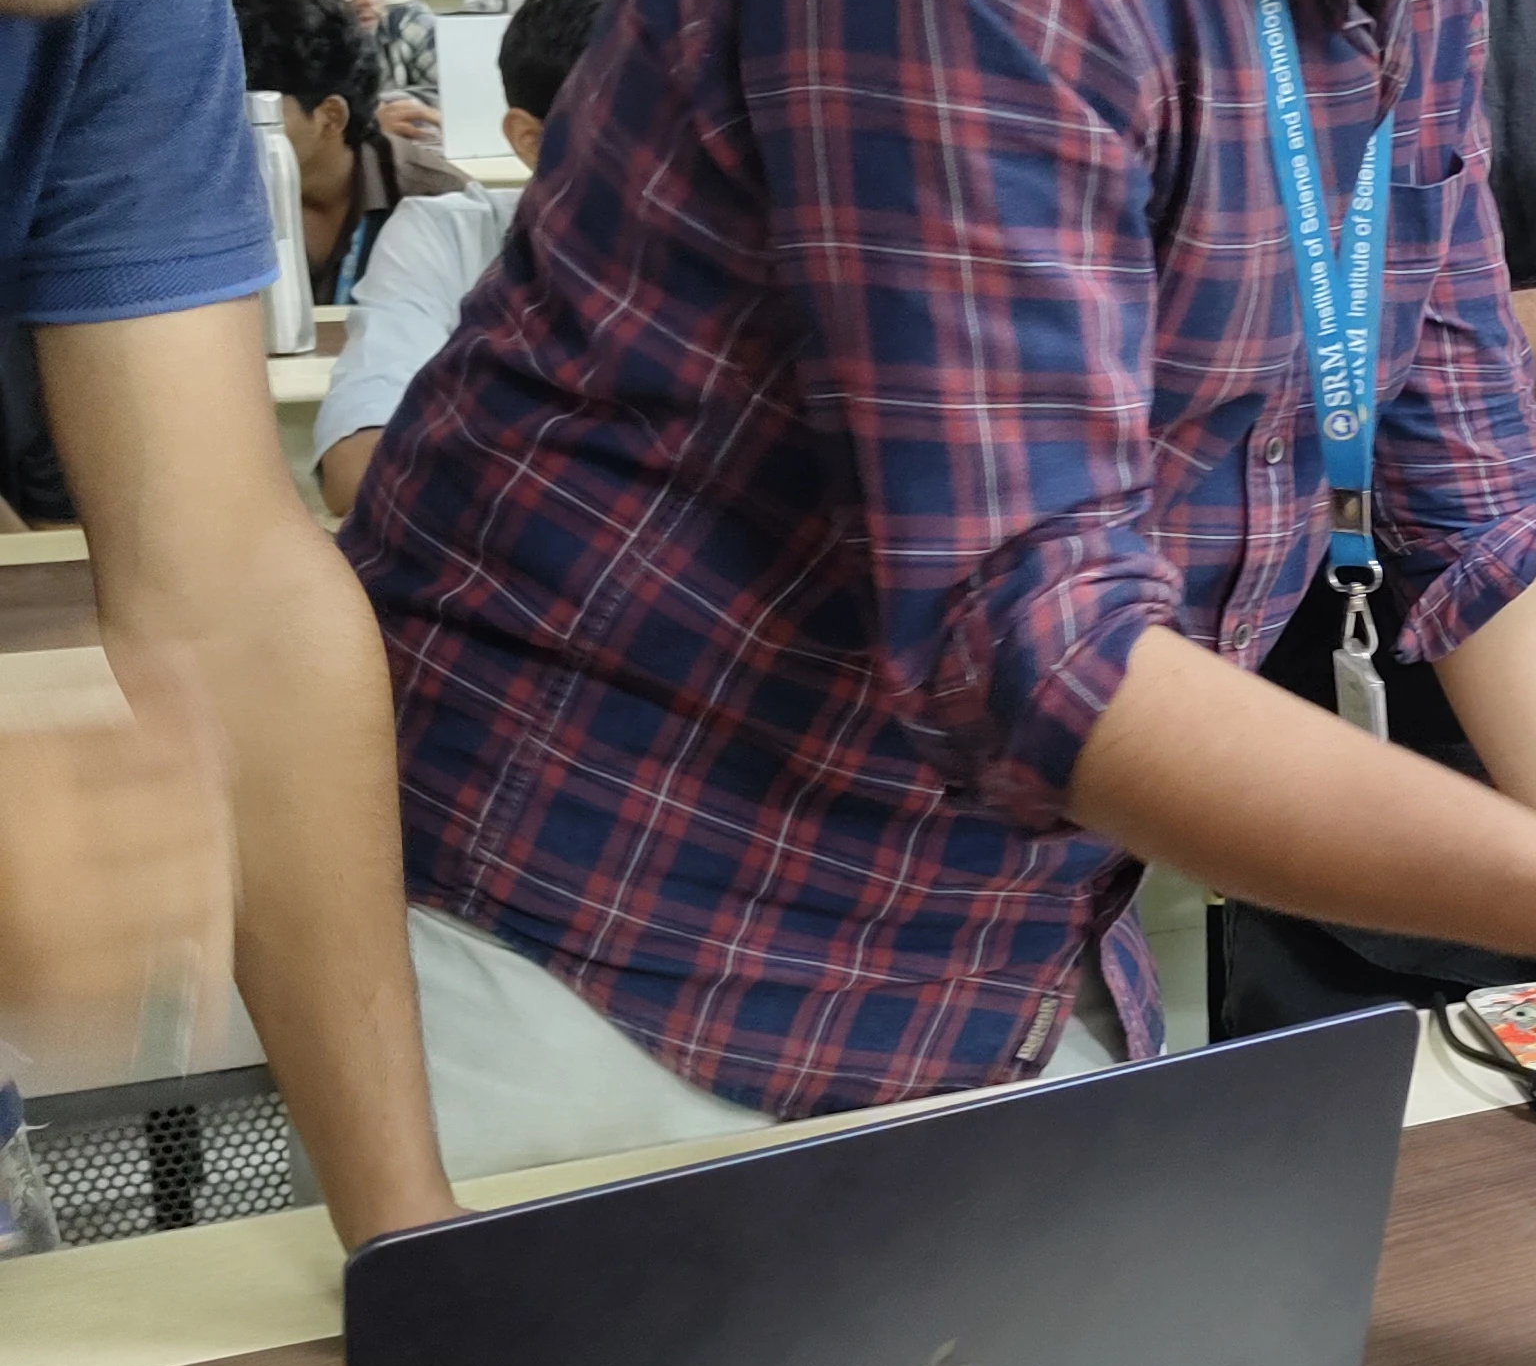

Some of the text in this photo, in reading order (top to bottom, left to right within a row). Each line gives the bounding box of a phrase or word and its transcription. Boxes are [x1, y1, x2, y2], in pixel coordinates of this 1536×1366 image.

[1280, 111, 1305, 150] and
[1291, 154, 1320, 235] Science
[1351, 215, 1373, 236] of
[1302, 237, 1325, 258] of
[1346, 241, 1371, 317] Institute
[1309, 261, 1338, 336] Institute
[1317, 341, 1352, 408] SRM
